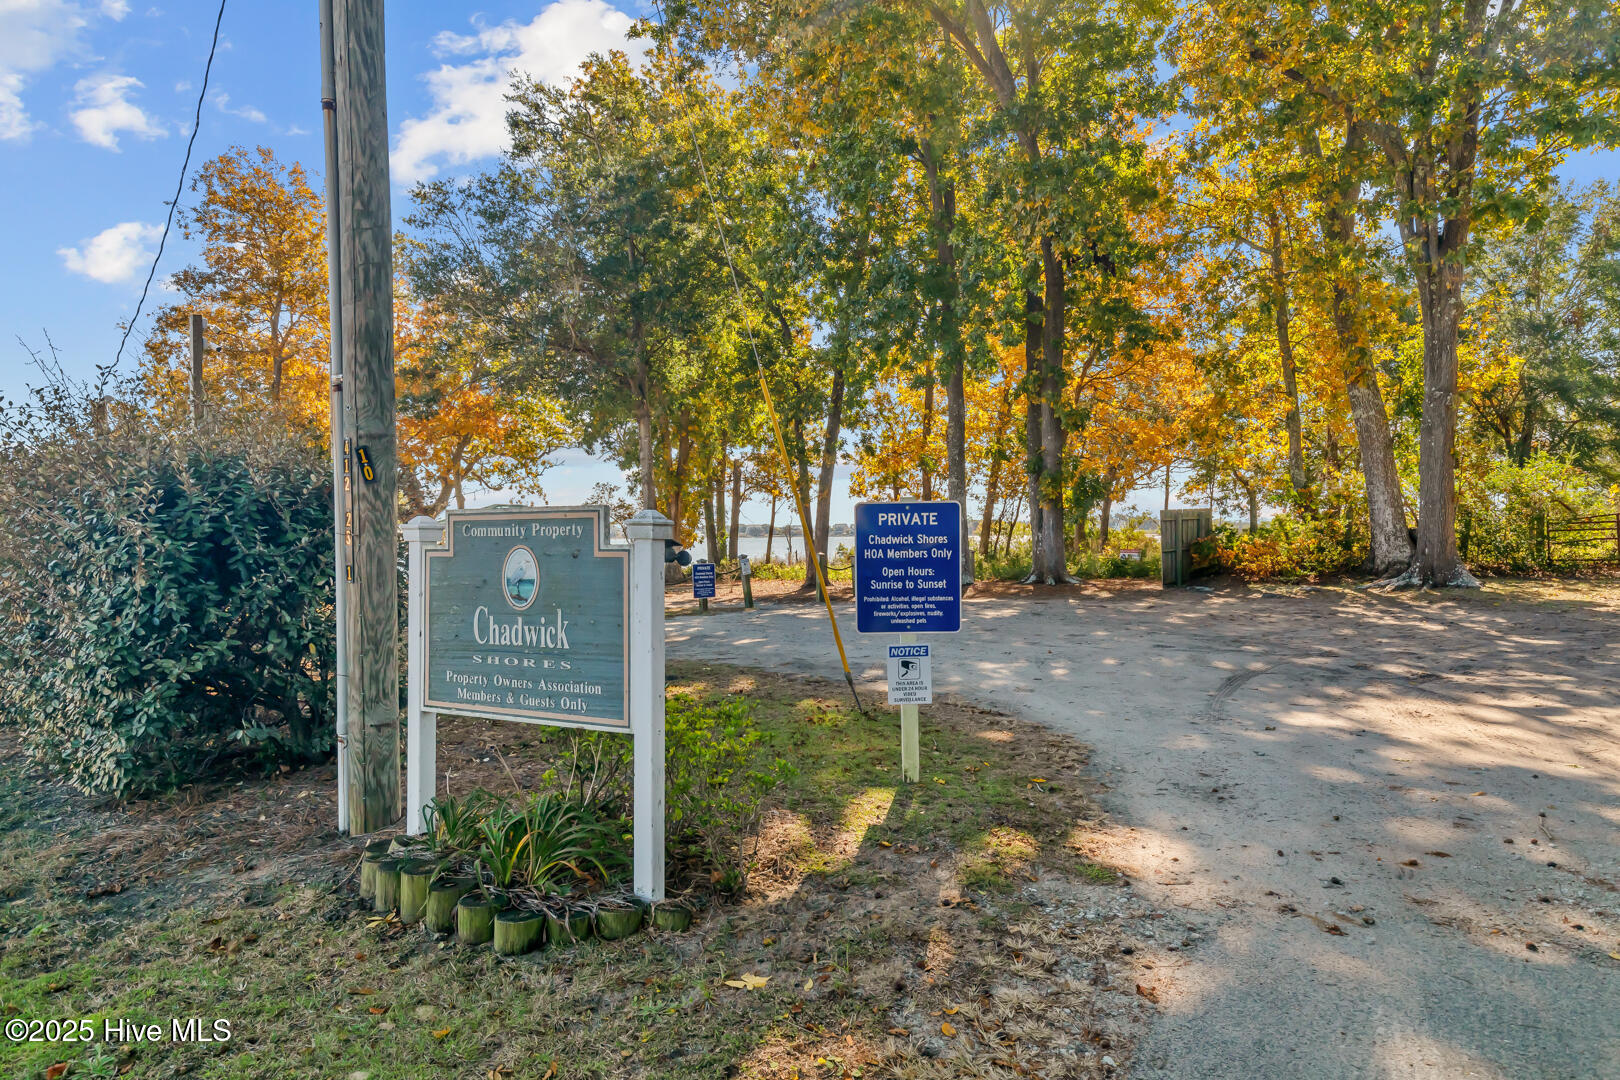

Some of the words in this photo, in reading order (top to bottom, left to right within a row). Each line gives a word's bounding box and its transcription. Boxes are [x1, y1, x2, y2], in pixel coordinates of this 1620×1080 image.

[358, 448, 374, 481] 10
[878, 512, 938, 526] PRIVATE
[462, 523, 527, 539] Community
[532, 523, 583, 539] Property
[868, 534, 914, 545] Chadwick
[917, 534, 948, 544] Shores
[864, 549, 884, 559] HOA
[887, 548, 928, 559] Members
[931, 548, 952, 560] Only
[882, 567, 905, 578] Open
[907, 566, 935, 576] Hours:
[870, 580, 903, 590] Sunrise
[905, 580, 914, 589] to
[917, 579, 947, 589] Sunset
[473, 605, 570, 650] Chadwick
[890, 647, 927, 656] NOTICE
[472, 655, 572, 670] SHORES
[445, 670, 489, 687] Property
[493, 674, 533, 690] Owners
[538, 679, 602, 695] Association
[457, 688, 501, 703] Members
[506, 692, 514, 704] &
[520, 694, 555, 709] Guests
[560, 696, 588, 713] Only
